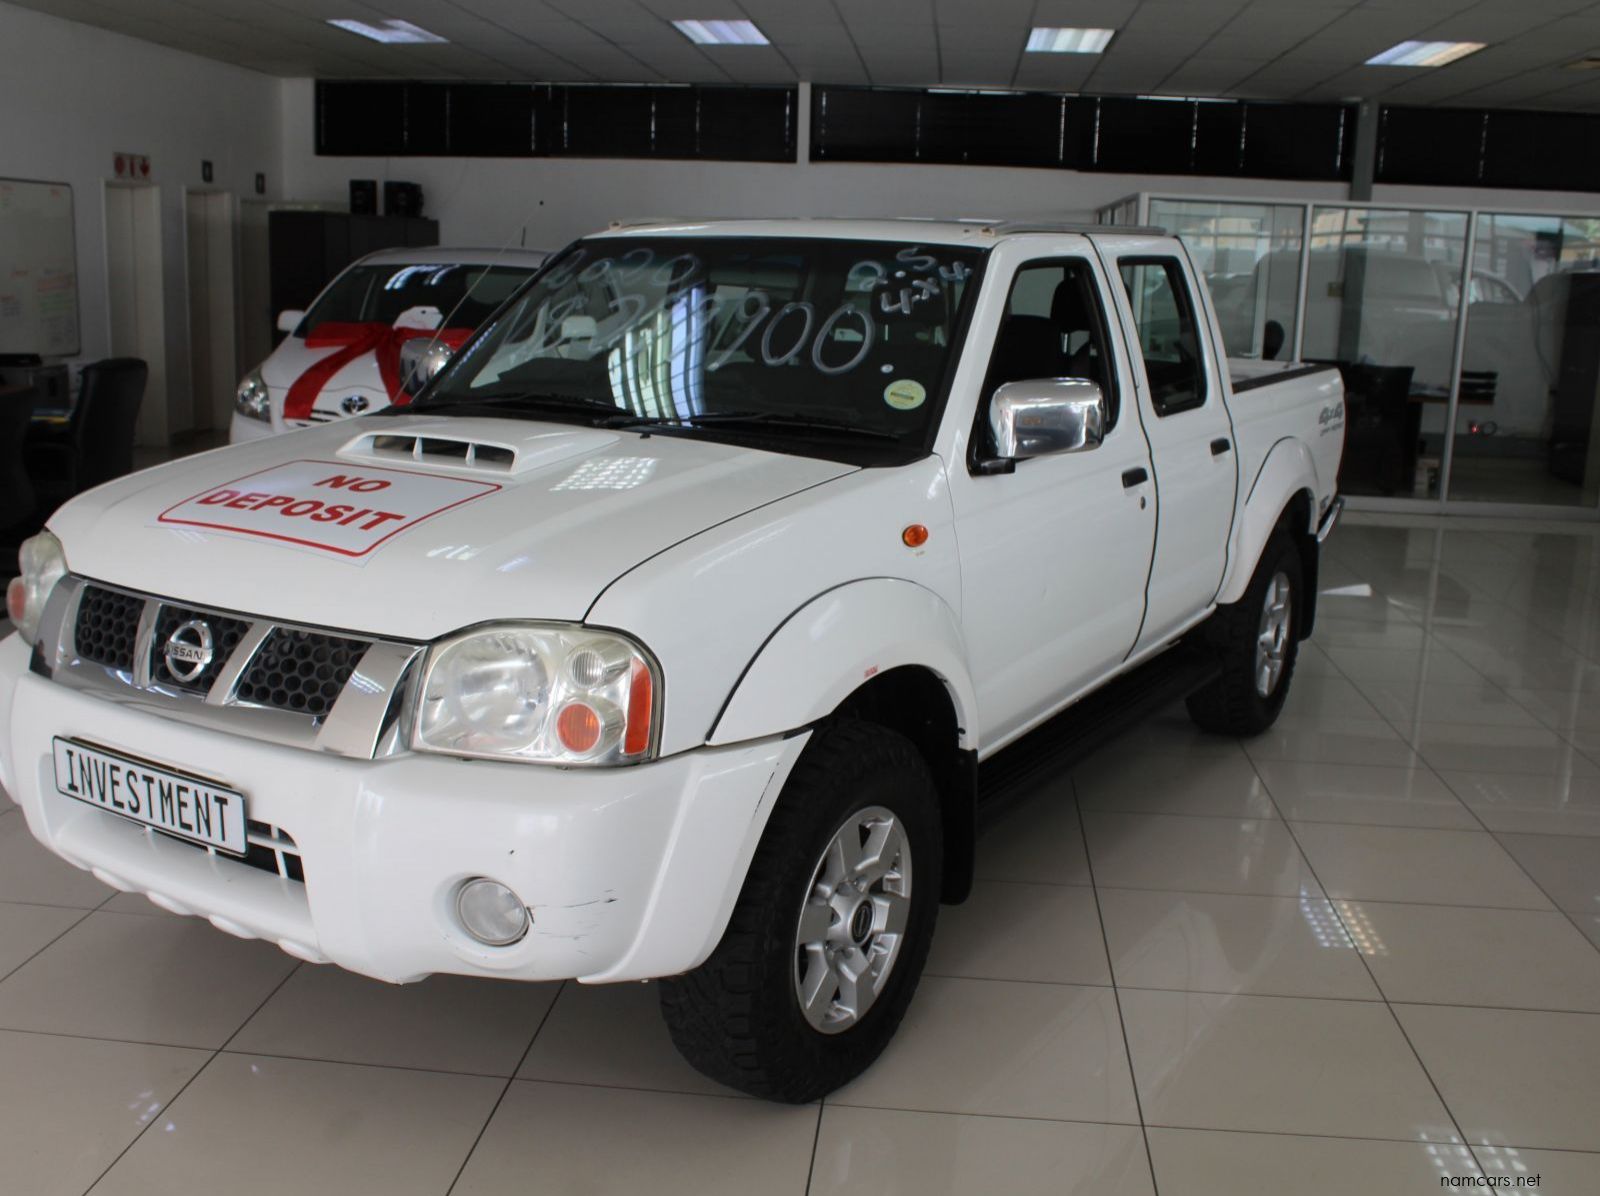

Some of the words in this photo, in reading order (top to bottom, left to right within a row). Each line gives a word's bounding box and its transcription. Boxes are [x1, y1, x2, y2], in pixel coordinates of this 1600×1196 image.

[313, 474, 392, 493] NO
[195, 489, 406, 531] DEPOSIT
[165, 641, 204, 661] NISSAN
[65, 749, 229, 842] INVESTMENT
